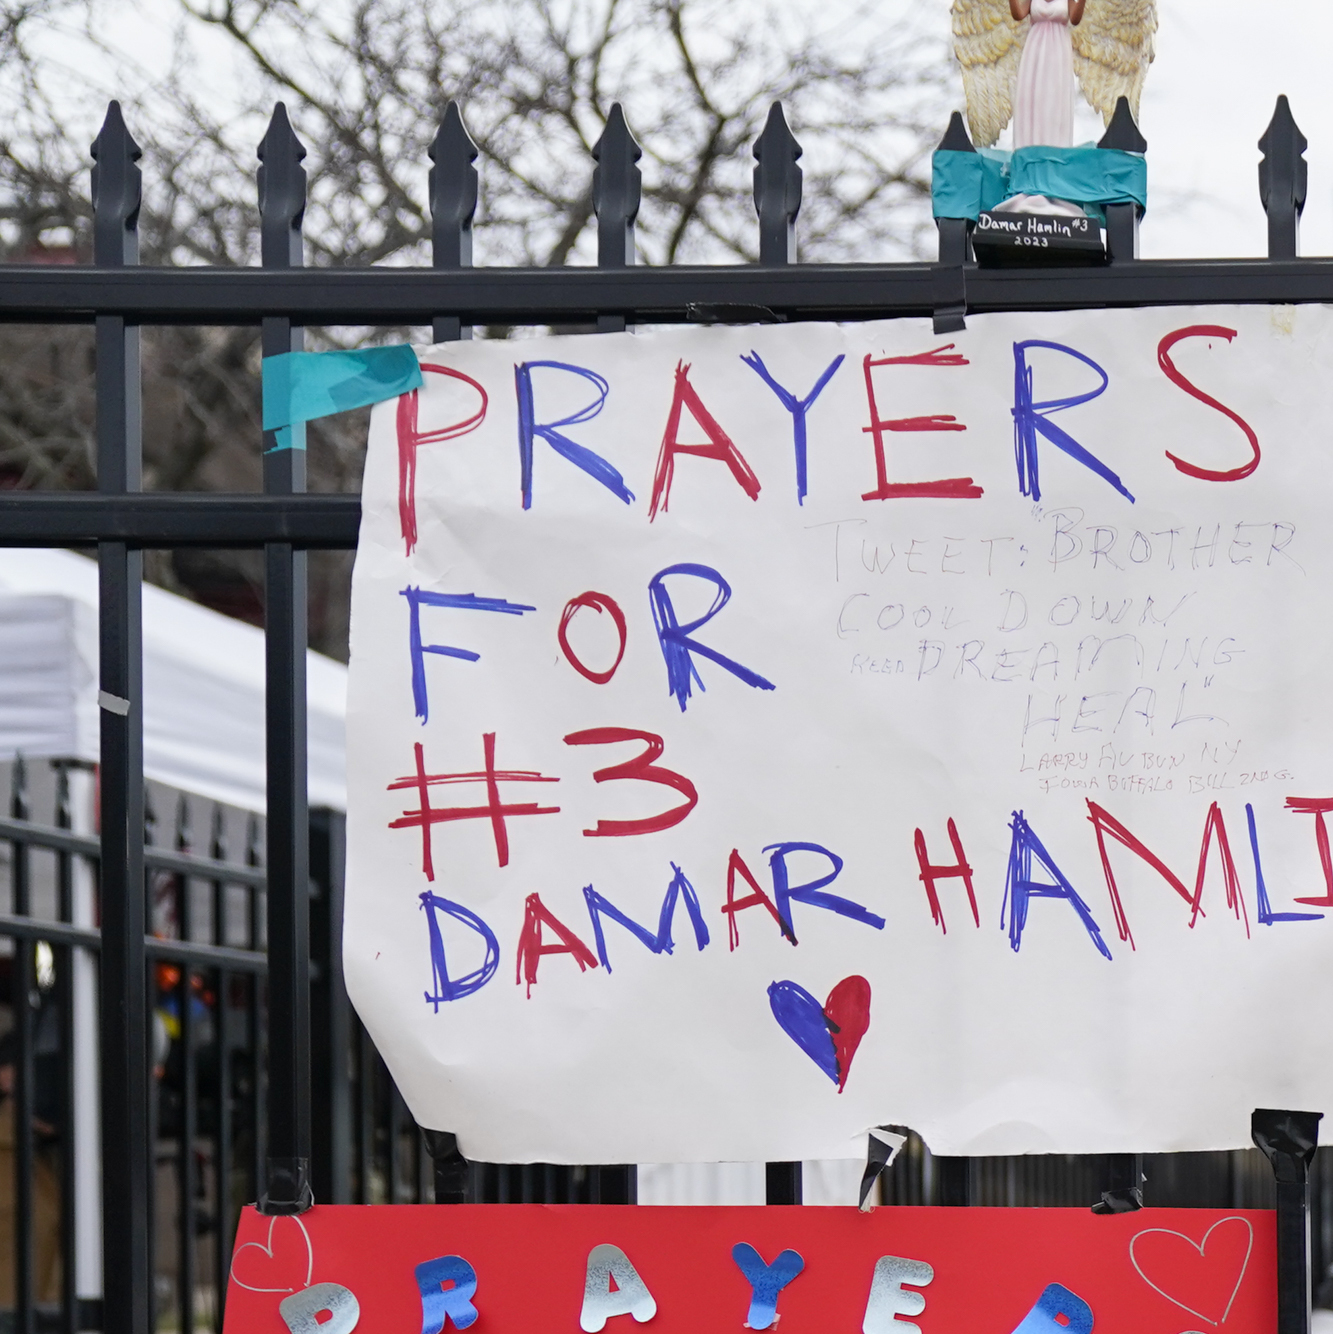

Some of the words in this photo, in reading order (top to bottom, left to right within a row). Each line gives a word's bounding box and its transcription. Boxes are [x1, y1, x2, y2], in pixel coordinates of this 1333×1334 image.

[978, 213, 1022, 232] Damar
[1027, 217, 1071, 237] Hamlin
[1072, 219, 1088, 232] #3
[1014, 236, 1048, 247] 2023
[396, 325, 1262, 556] PRAYERS
[400, 563, 776, 726] FOR
[387, 726, 698, 880] #3
[419, 840, 885, 1011] DAMAR
